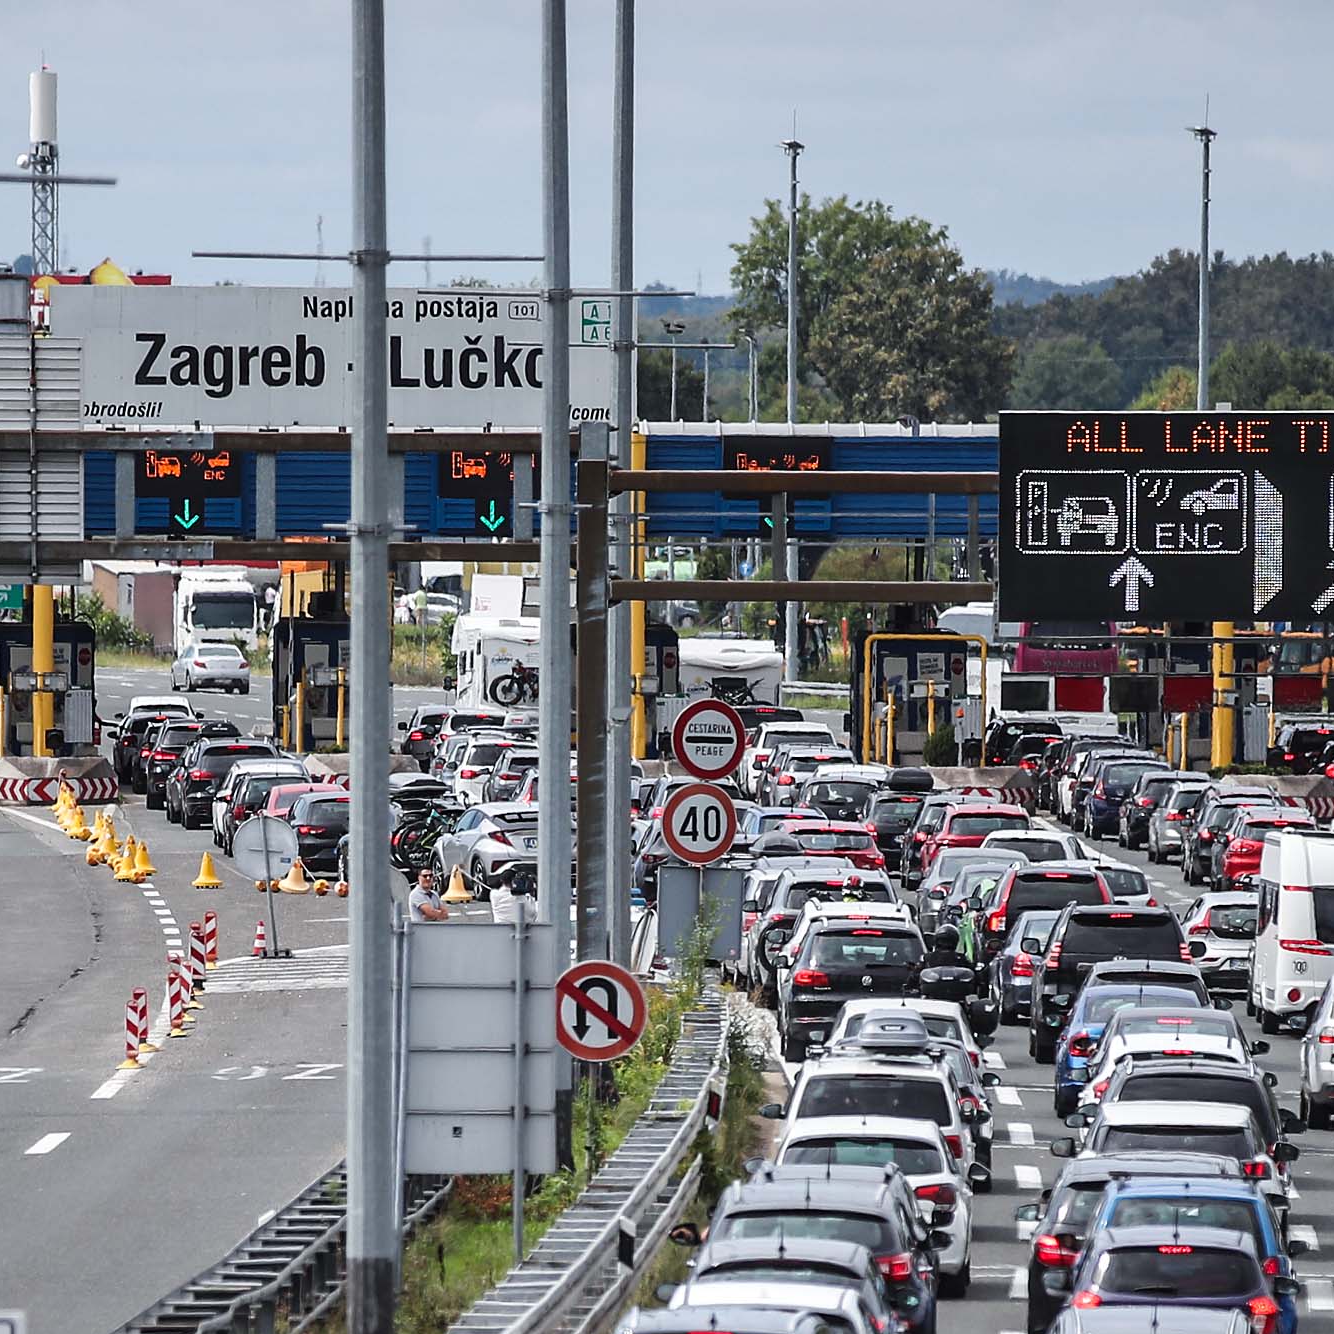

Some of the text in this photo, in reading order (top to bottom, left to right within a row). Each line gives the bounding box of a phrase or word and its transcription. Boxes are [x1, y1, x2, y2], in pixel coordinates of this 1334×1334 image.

[415, 297, 498, 323] postaja
[515, 305, 535, 316] 101
[590, 304, 599, 319] A
[590, 326, 599, 340] A
[135, 333, 325, 398] Zagreb
[1067, 421, 1144, 453] ALL
[1166, 420, 1270, 453] LANE
[204, 470, 226, 480] ENC
[1155, 523, 1223, 549] ENC
[688, 723, 732, 735] CESTARINA
[696, 746, 724, 756] PEAGE
[679, 805, 722, 842] 40
